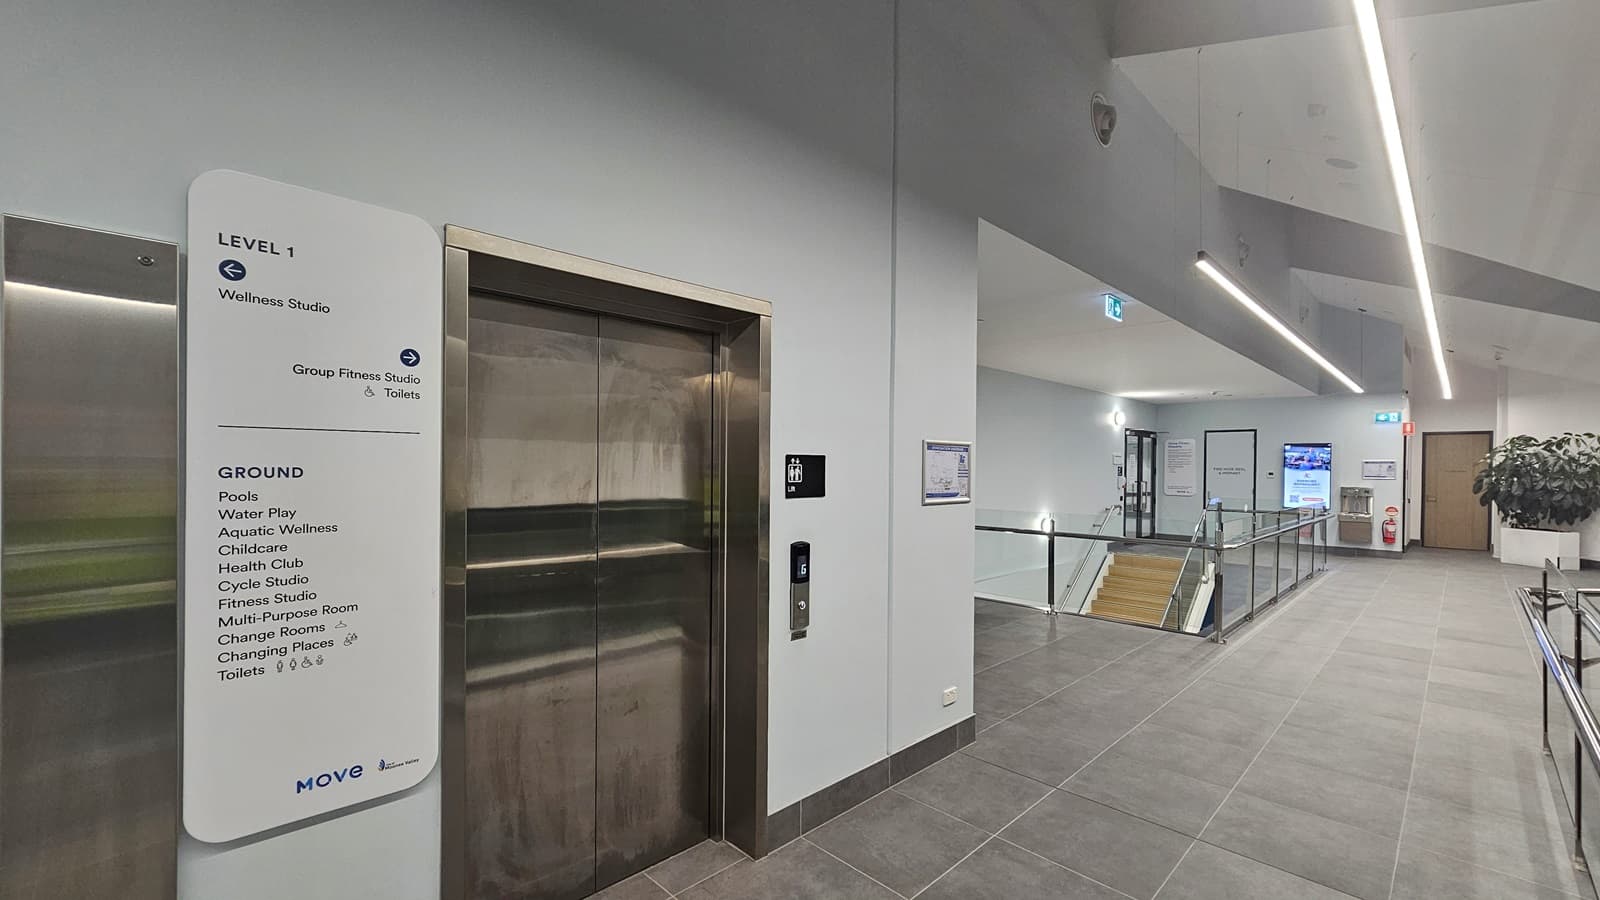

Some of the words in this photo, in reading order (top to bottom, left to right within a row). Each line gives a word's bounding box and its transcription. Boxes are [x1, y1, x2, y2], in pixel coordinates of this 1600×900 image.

[218, 232, 281, 256] LEVEL
[287, 246, 295, 258] 1
[218, 287, 284, 308] Wellness
[288, 298, 331, 314] Studio
[292, 363, 335, 379] Group
[338, 367, 382, 382] Fitness
[384, 372, 421, 385] Studio
[383, 387, 421, 400] Toilets
[218, 466, 304, 479] GROUND
[218, 491, 259, 502] Pools
[218, 508, 264, 520] Water
[268, 507, 297, 520] Play
[218, 525, 275, 540] Aquatic
[279, 523, 338, 535] Wellness
[218, 543, 288, 556] Childcare
[218, 560, 267, 574] Health
[271, 557, 304, 570] Club
[218, 579, 261, 593] Cycle
[265, 574, 309, 588] Studio
[218, 596, 270, 610] Fitness
[273, 590, 317, 604] Studio
[218, 607, 318, 628] Multi-Purpose
[322, 603, 359, 616] Room
[217, 630, 276, 646] Change
[280, 622, 326, 638] Rooms
[217, 645, 288, 663] Changing
[292, 638, 335, 653] Places
[217, 665, 265, 682] Toilets
